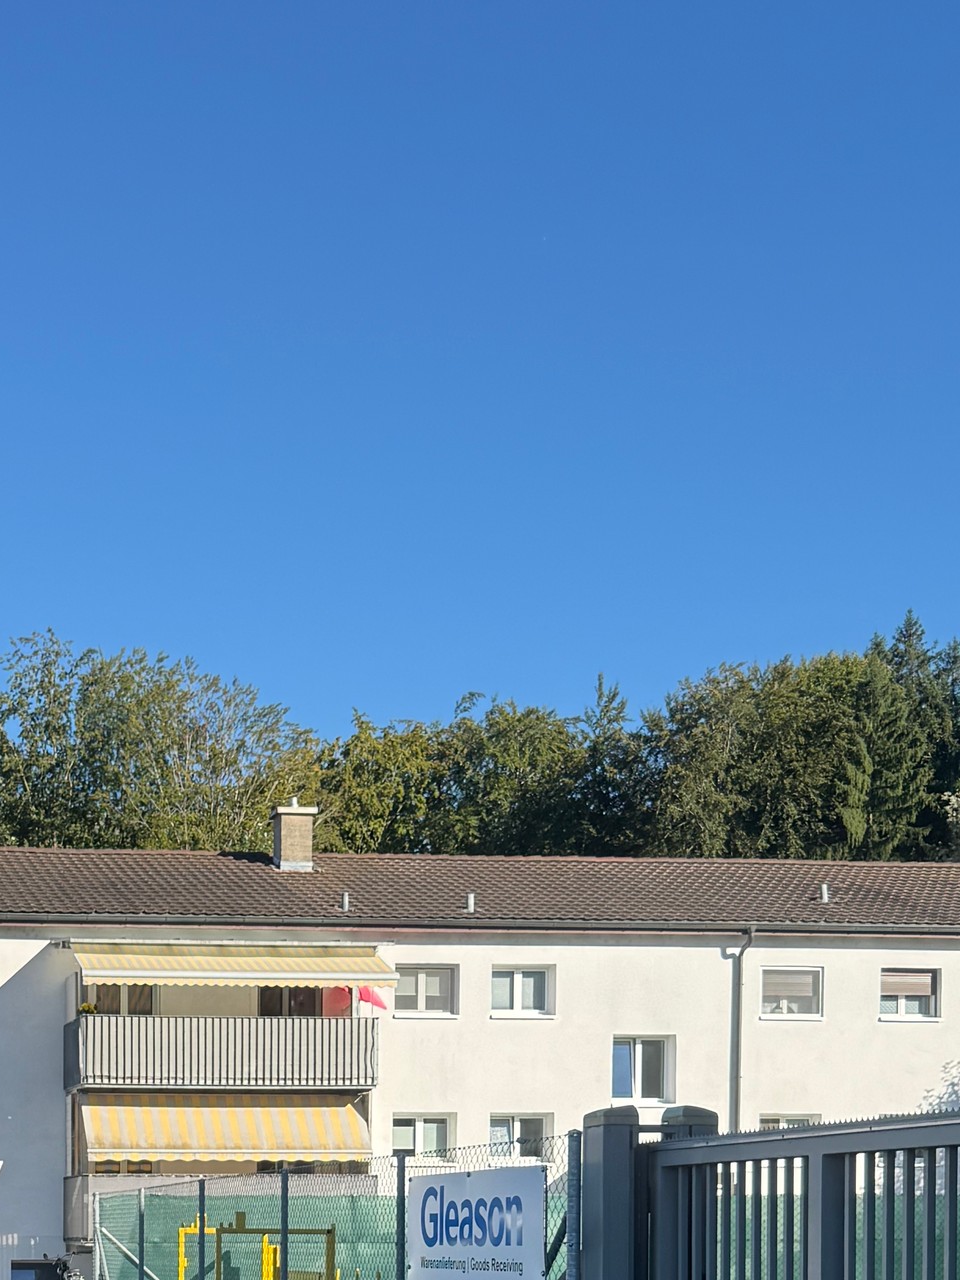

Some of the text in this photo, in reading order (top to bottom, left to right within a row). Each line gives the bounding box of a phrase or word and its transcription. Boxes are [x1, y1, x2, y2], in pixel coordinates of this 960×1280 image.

[421, 1185, 523, 1248] Gleason
[420, 1256, 466, 1273] Warenanlieferung
[470, 1257, 490, 1271] Goods
[491, 1257, 523, 1276] Receiving
